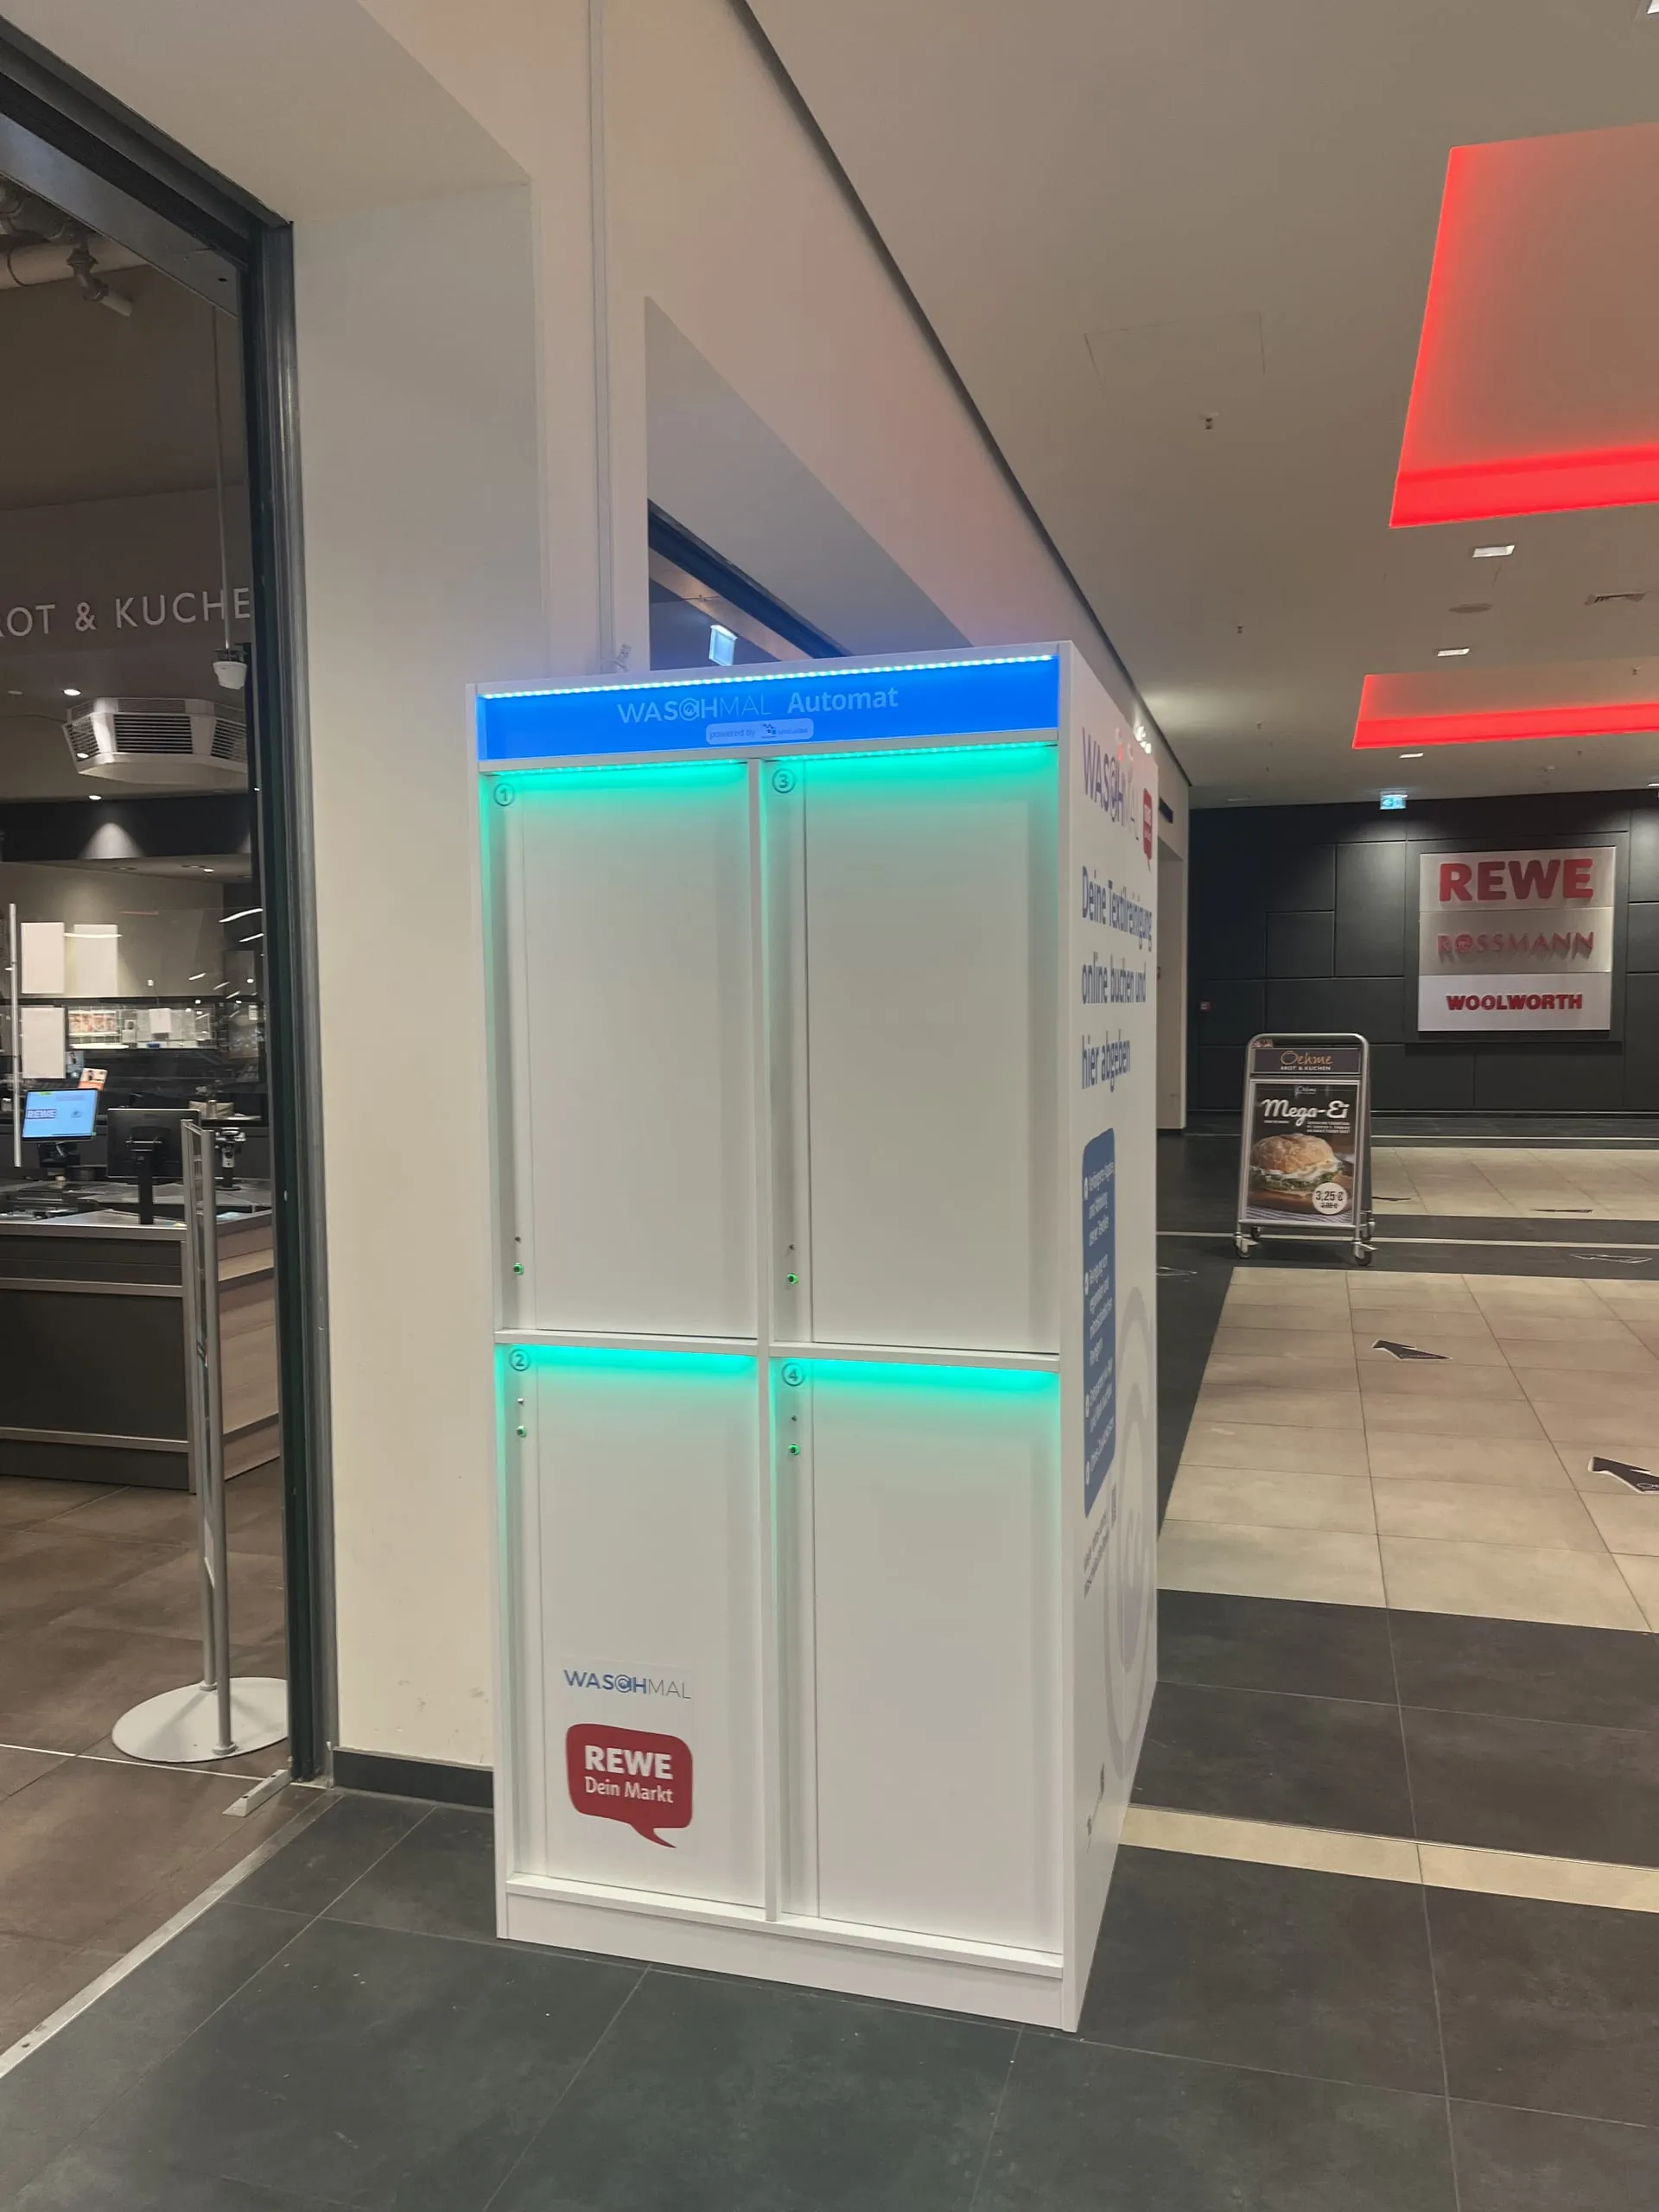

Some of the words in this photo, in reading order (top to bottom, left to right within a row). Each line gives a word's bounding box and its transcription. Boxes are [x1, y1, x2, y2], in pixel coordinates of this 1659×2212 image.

[0, 604, 55, 637] OT
[75, 602, 96, 632] &
[116, 588, 251, 629] KUCHE
[787, 687, 899, 714] Automat
[1439, 858, 1593, 901] REWE
[1082, 866, 1106, 925] Deine
[1437, 931, 1594, 956] ROSSMANN
[1082, 951, 1108, 1003] online
[1446, 995, 1582, 1010] WOOLWORTH
[1082, 1035, 1099, 1089] hier
[1101, 1029, 1131, 1092] abgeben
[1281, 1050, 1333, 1065] Oehme
[1262, 1098, 1350, 1127] Mega-Ei
[1315, 1191, 1335, 1202] 3,25
[584, 1745, 673, 1780] REWE
[584, 1777, 620, 1796] Dein
[625, 1781, 674, 1803] Markt
